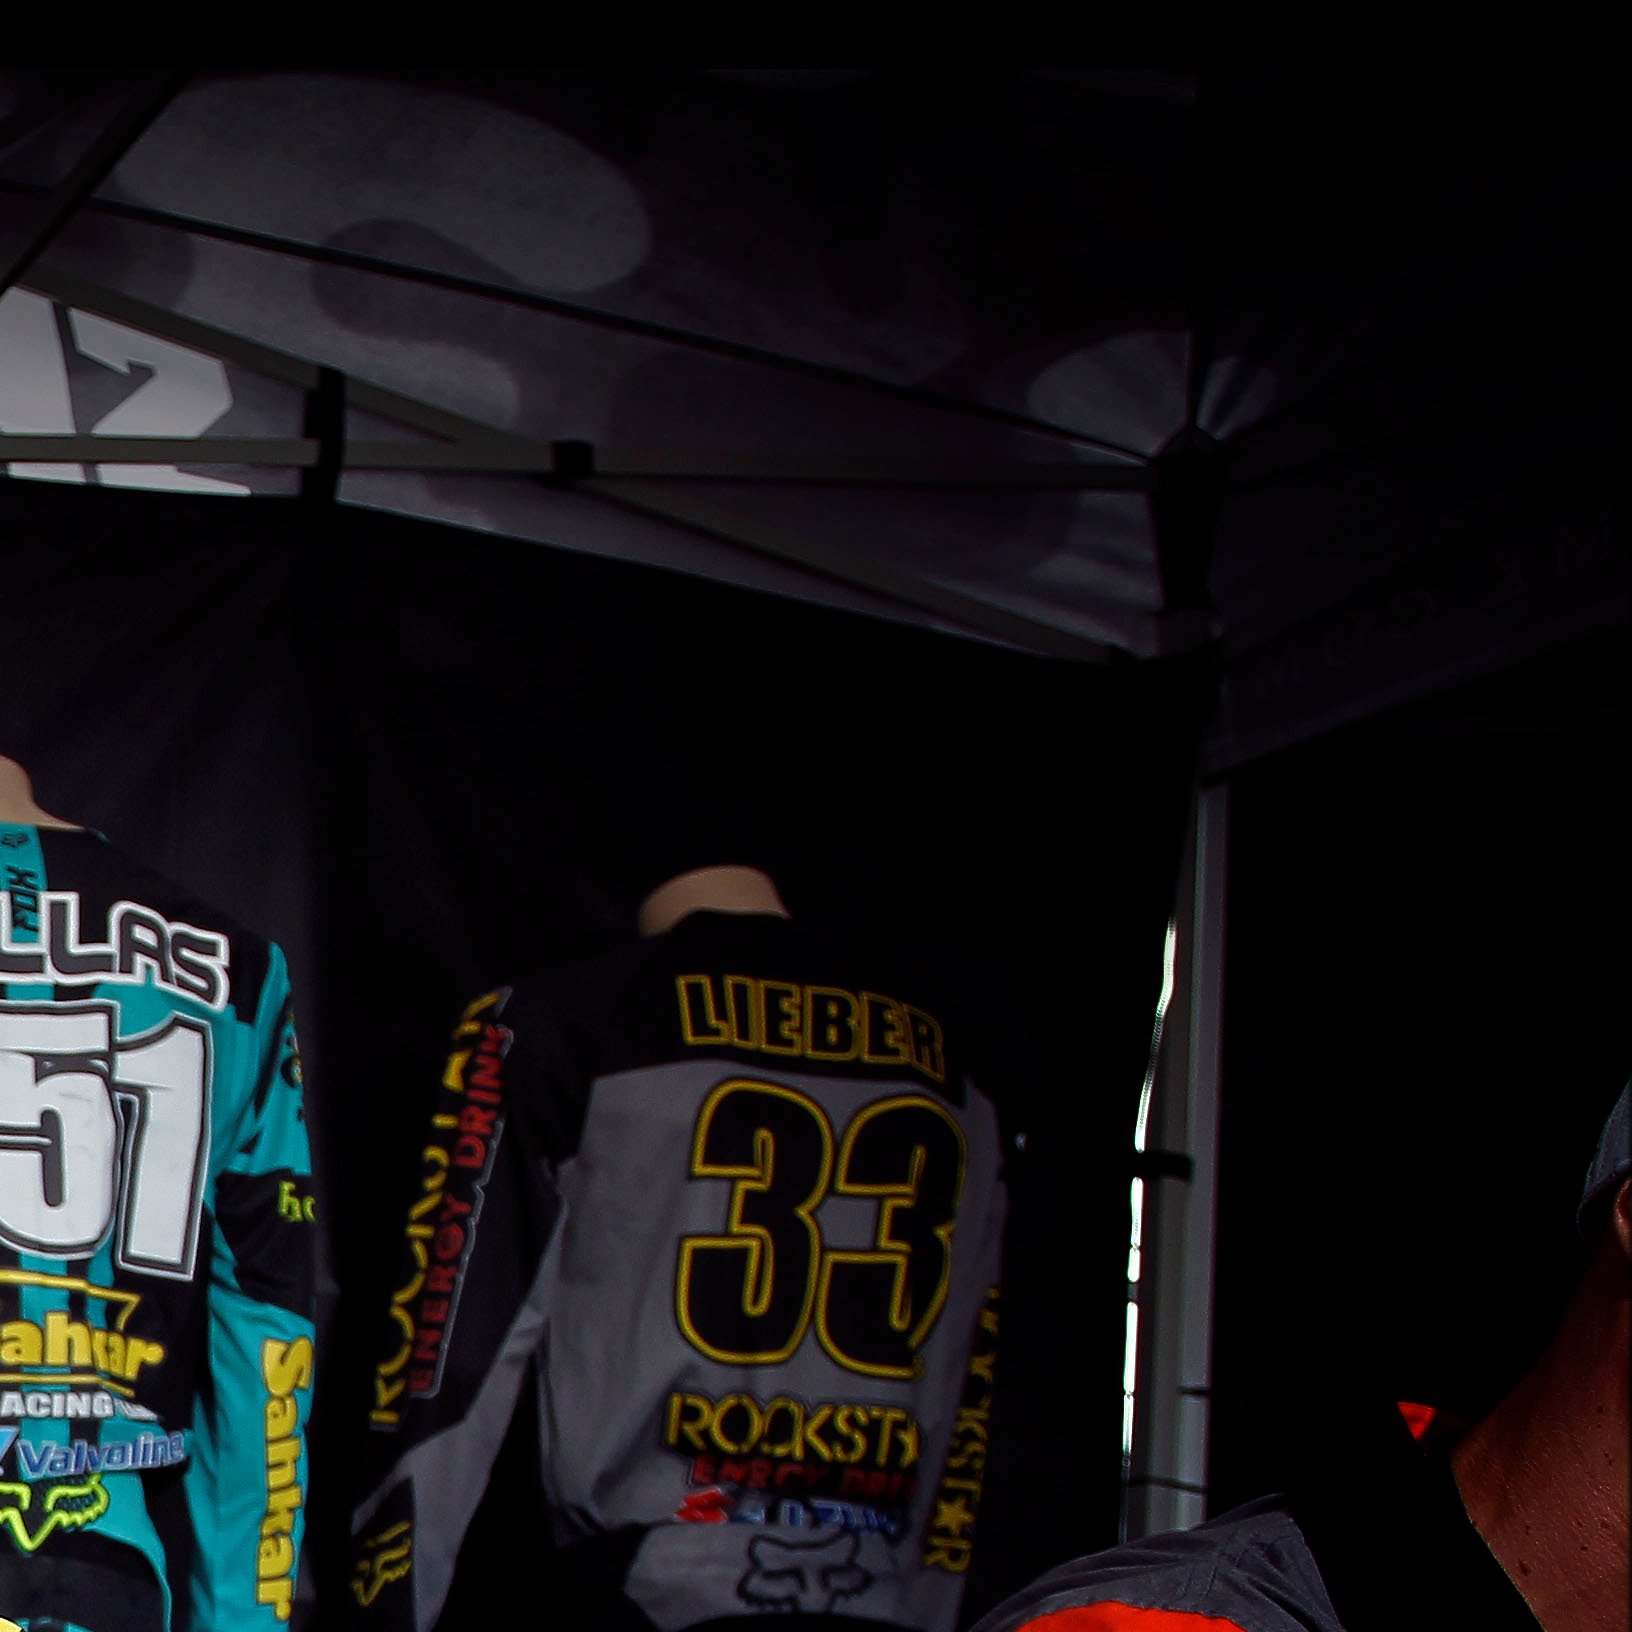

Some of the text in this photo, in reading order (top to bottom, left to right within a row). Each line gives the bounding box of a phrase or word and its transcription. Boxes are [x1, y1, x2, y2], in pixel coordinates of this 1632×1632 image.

[676, 975, 946, 1081] LIEBER
[675, 1078, 969, 1380] 33
[15, 1429, 189, 1481] Valvoline
[255, 1336, 315, 1621] Sahkar
